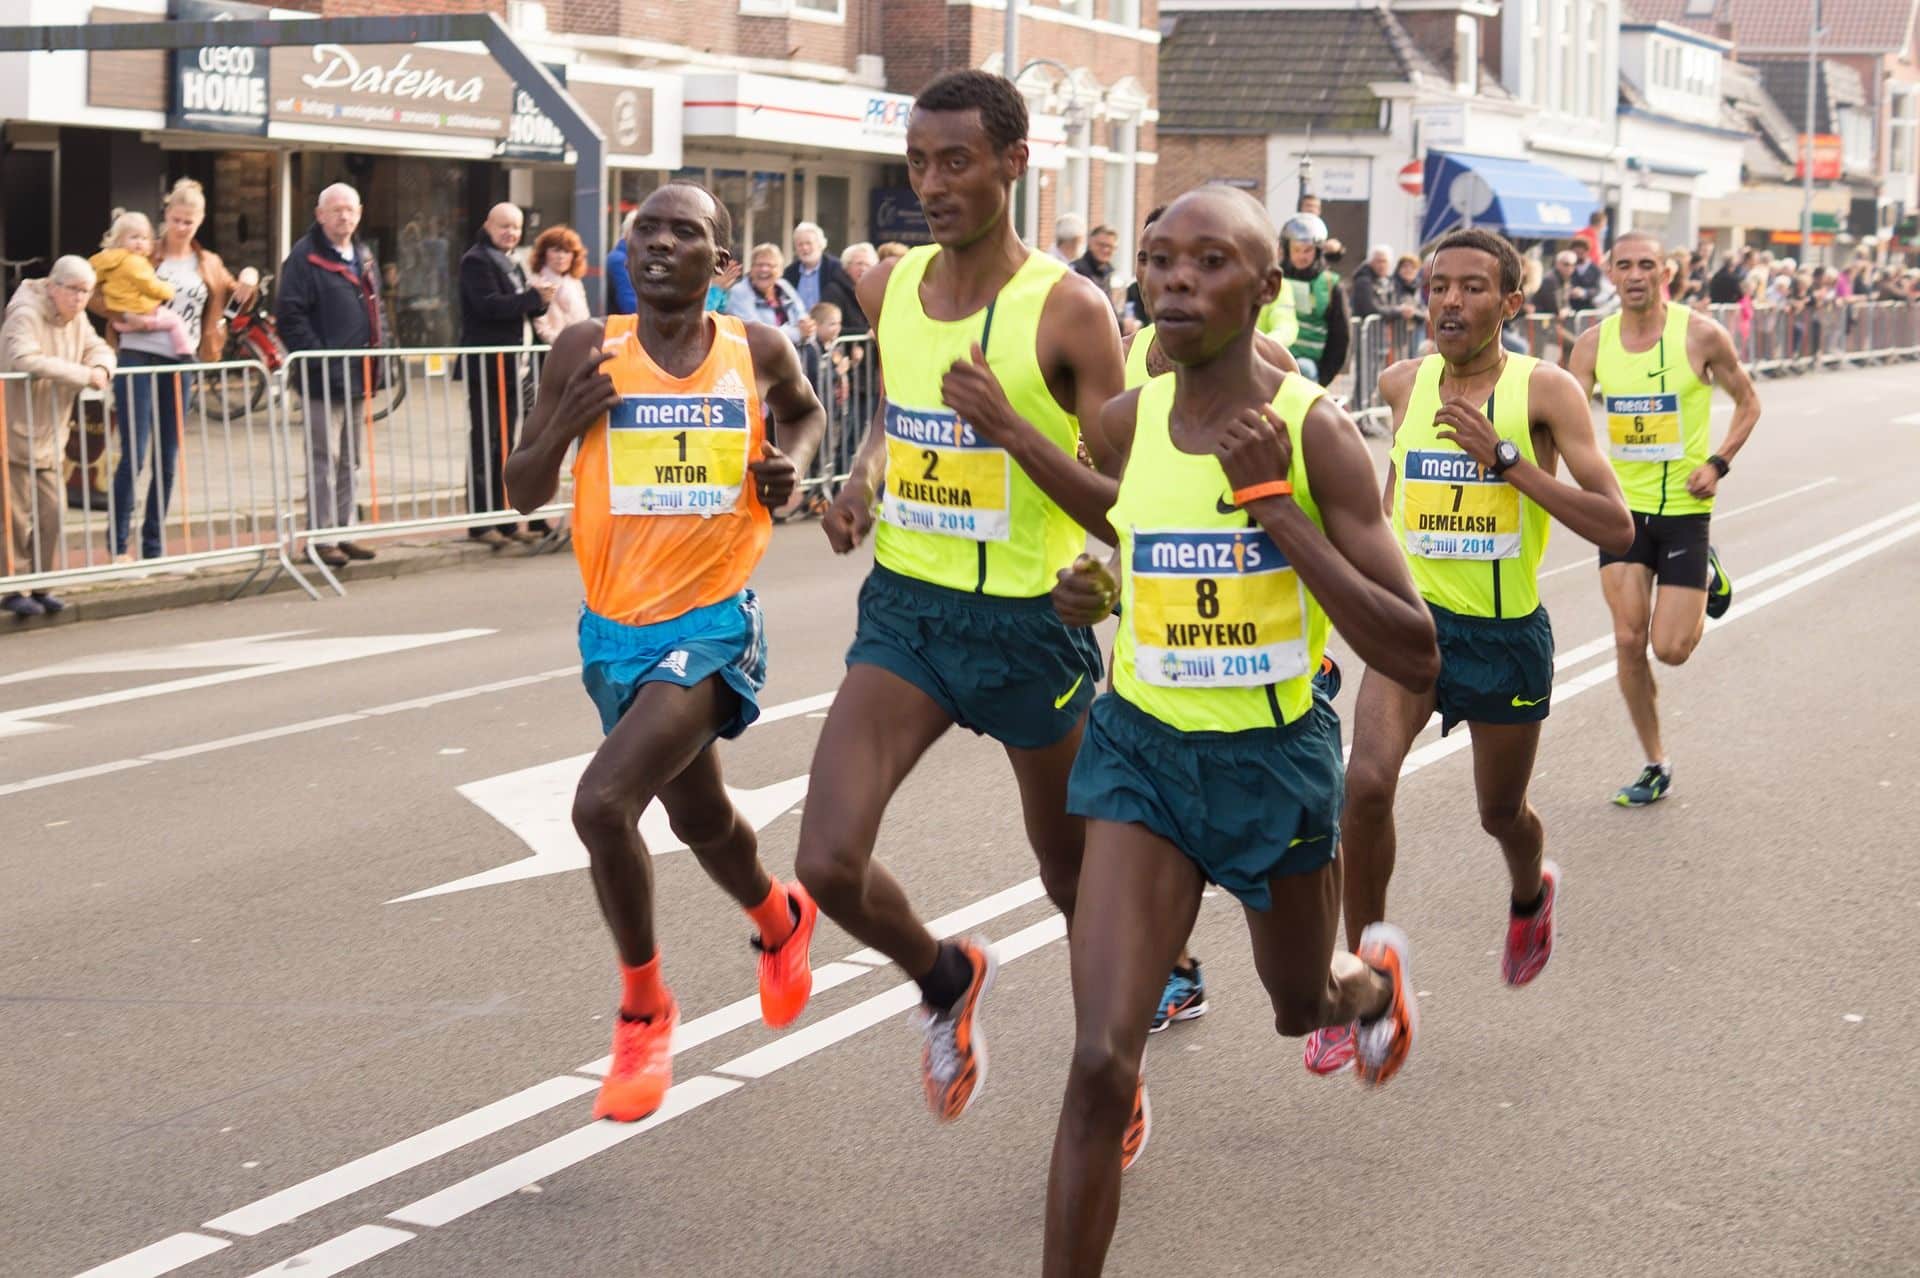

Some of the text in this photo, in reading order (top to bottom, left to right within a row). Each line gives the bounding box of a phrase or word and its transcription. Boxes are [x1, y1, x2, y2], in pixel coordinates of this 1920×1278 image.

[302, 44, 484, 103] Datema
[182, 72, 267, 113] HOME
[636, 397, 723, 427] menzis
[1614, 397, 1663, 414] menzis
[896, 413, 976, 448] menzis
[1634, 416, 1644, 433] 6
[673, 431, 687, 462] 1
[655, 465, 707, 484] YATOR
[922, 450, 939, 481] 2
[688, 490, 722, 507] 2014
[1450, 485, 1463, 512] 7
[939, 512, 975, 531] 2014
[1419, 514, 1496, 532] DEMELASH
[1152, 533, 1262, 574] menzis
[1462, 539, 1494, 553] 2014
[1196, 578, 1220, 619] 8
[1166, 622, 1257, 646] KIPYEKO
[1222, 653, 1271, 676] 2014
